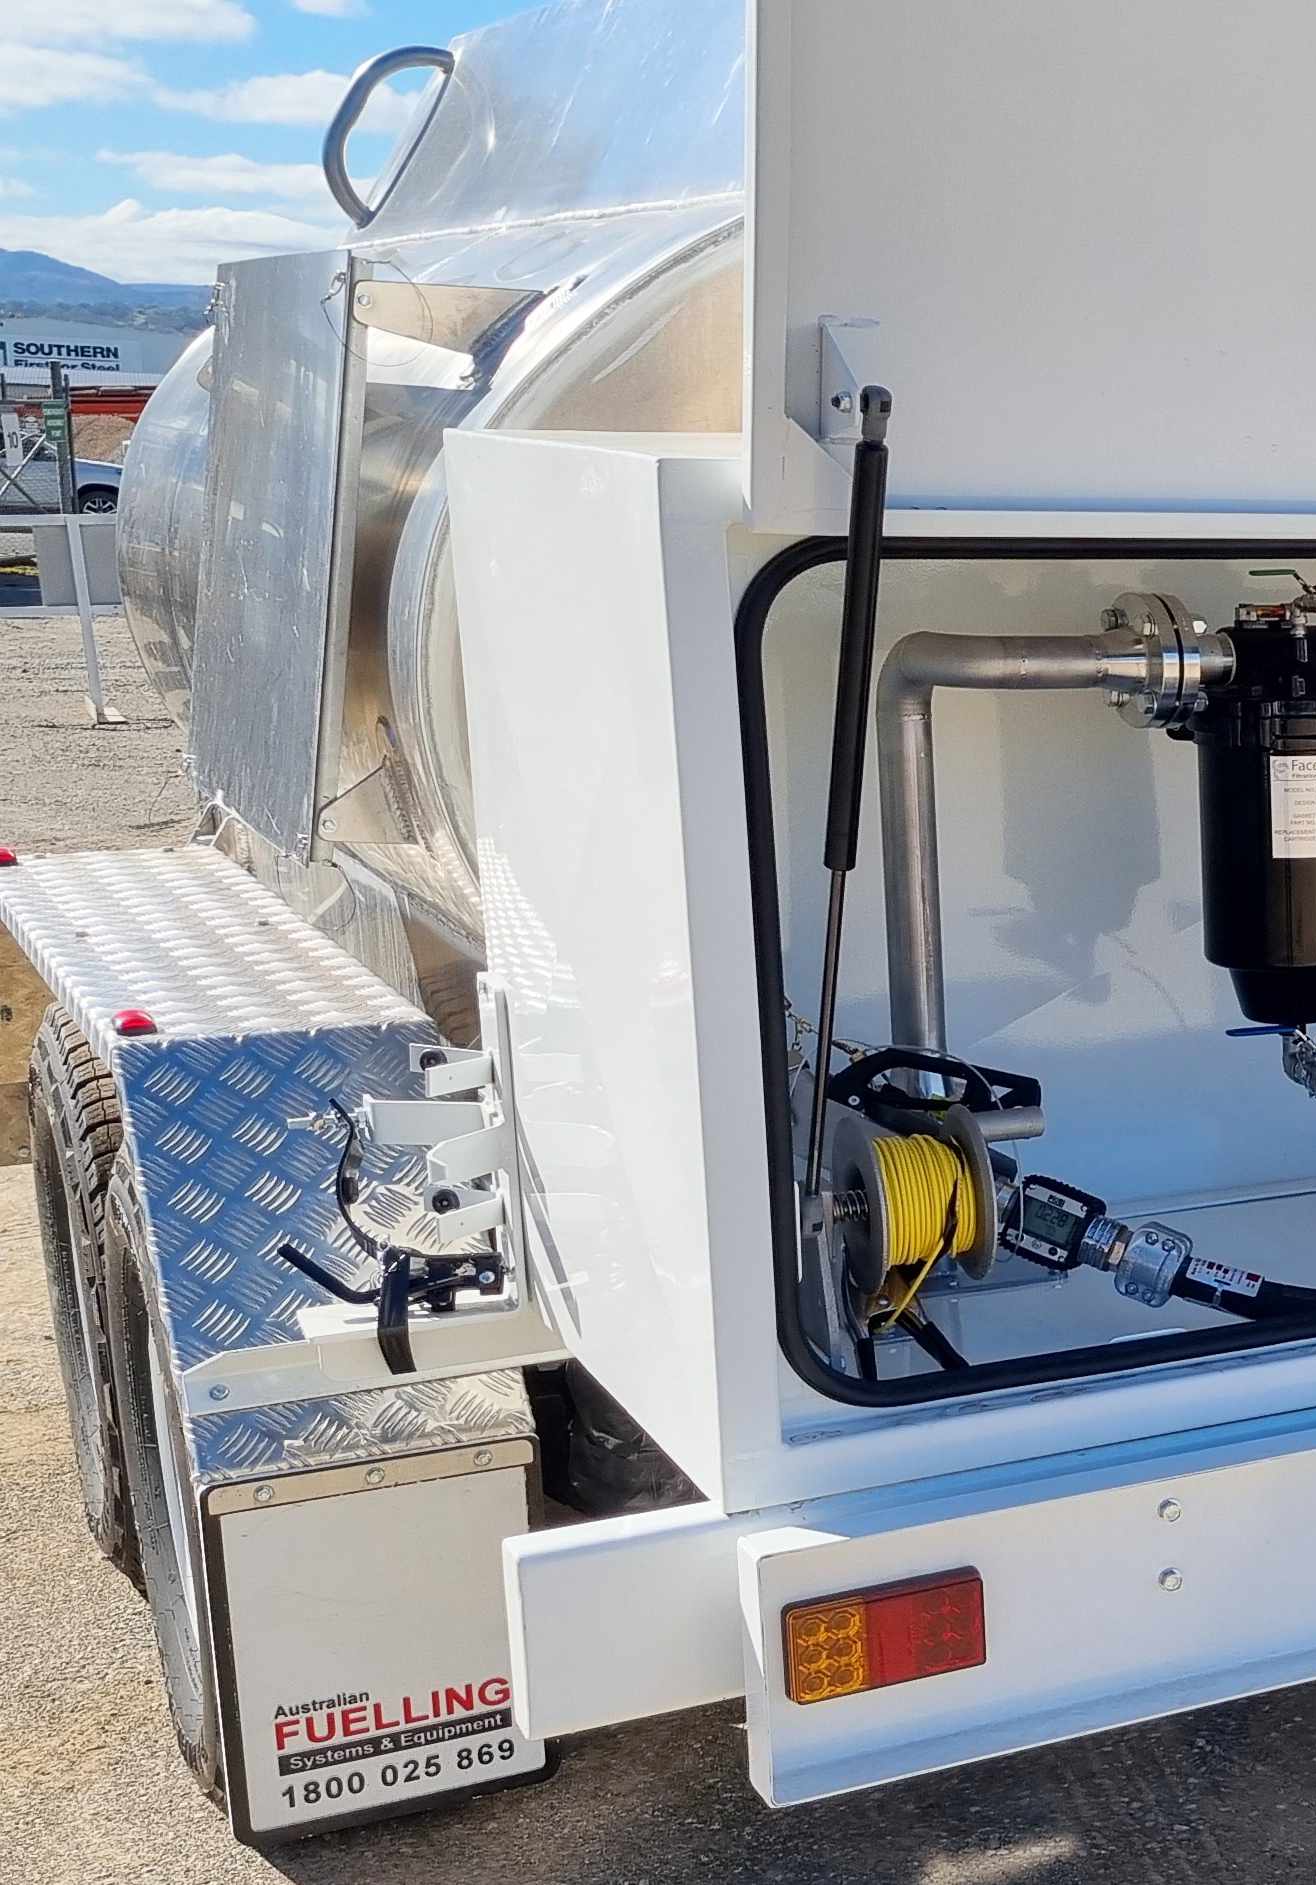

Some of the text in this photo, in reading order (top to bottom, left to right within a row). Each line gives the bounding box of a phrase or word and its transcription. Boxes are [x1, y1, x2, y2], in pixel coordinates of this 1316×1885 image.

[13, 341, 120, 359] SOUTHERN
[7, 431, 19, 449] 10
[273, 1691, 370, 1720] Australian
[274, 1677, 512, 1750] FUELLING
[289, 1714, 503, 1769] Systems & Equipment
[281, 1738, 515, 1809] 1800 025 869
